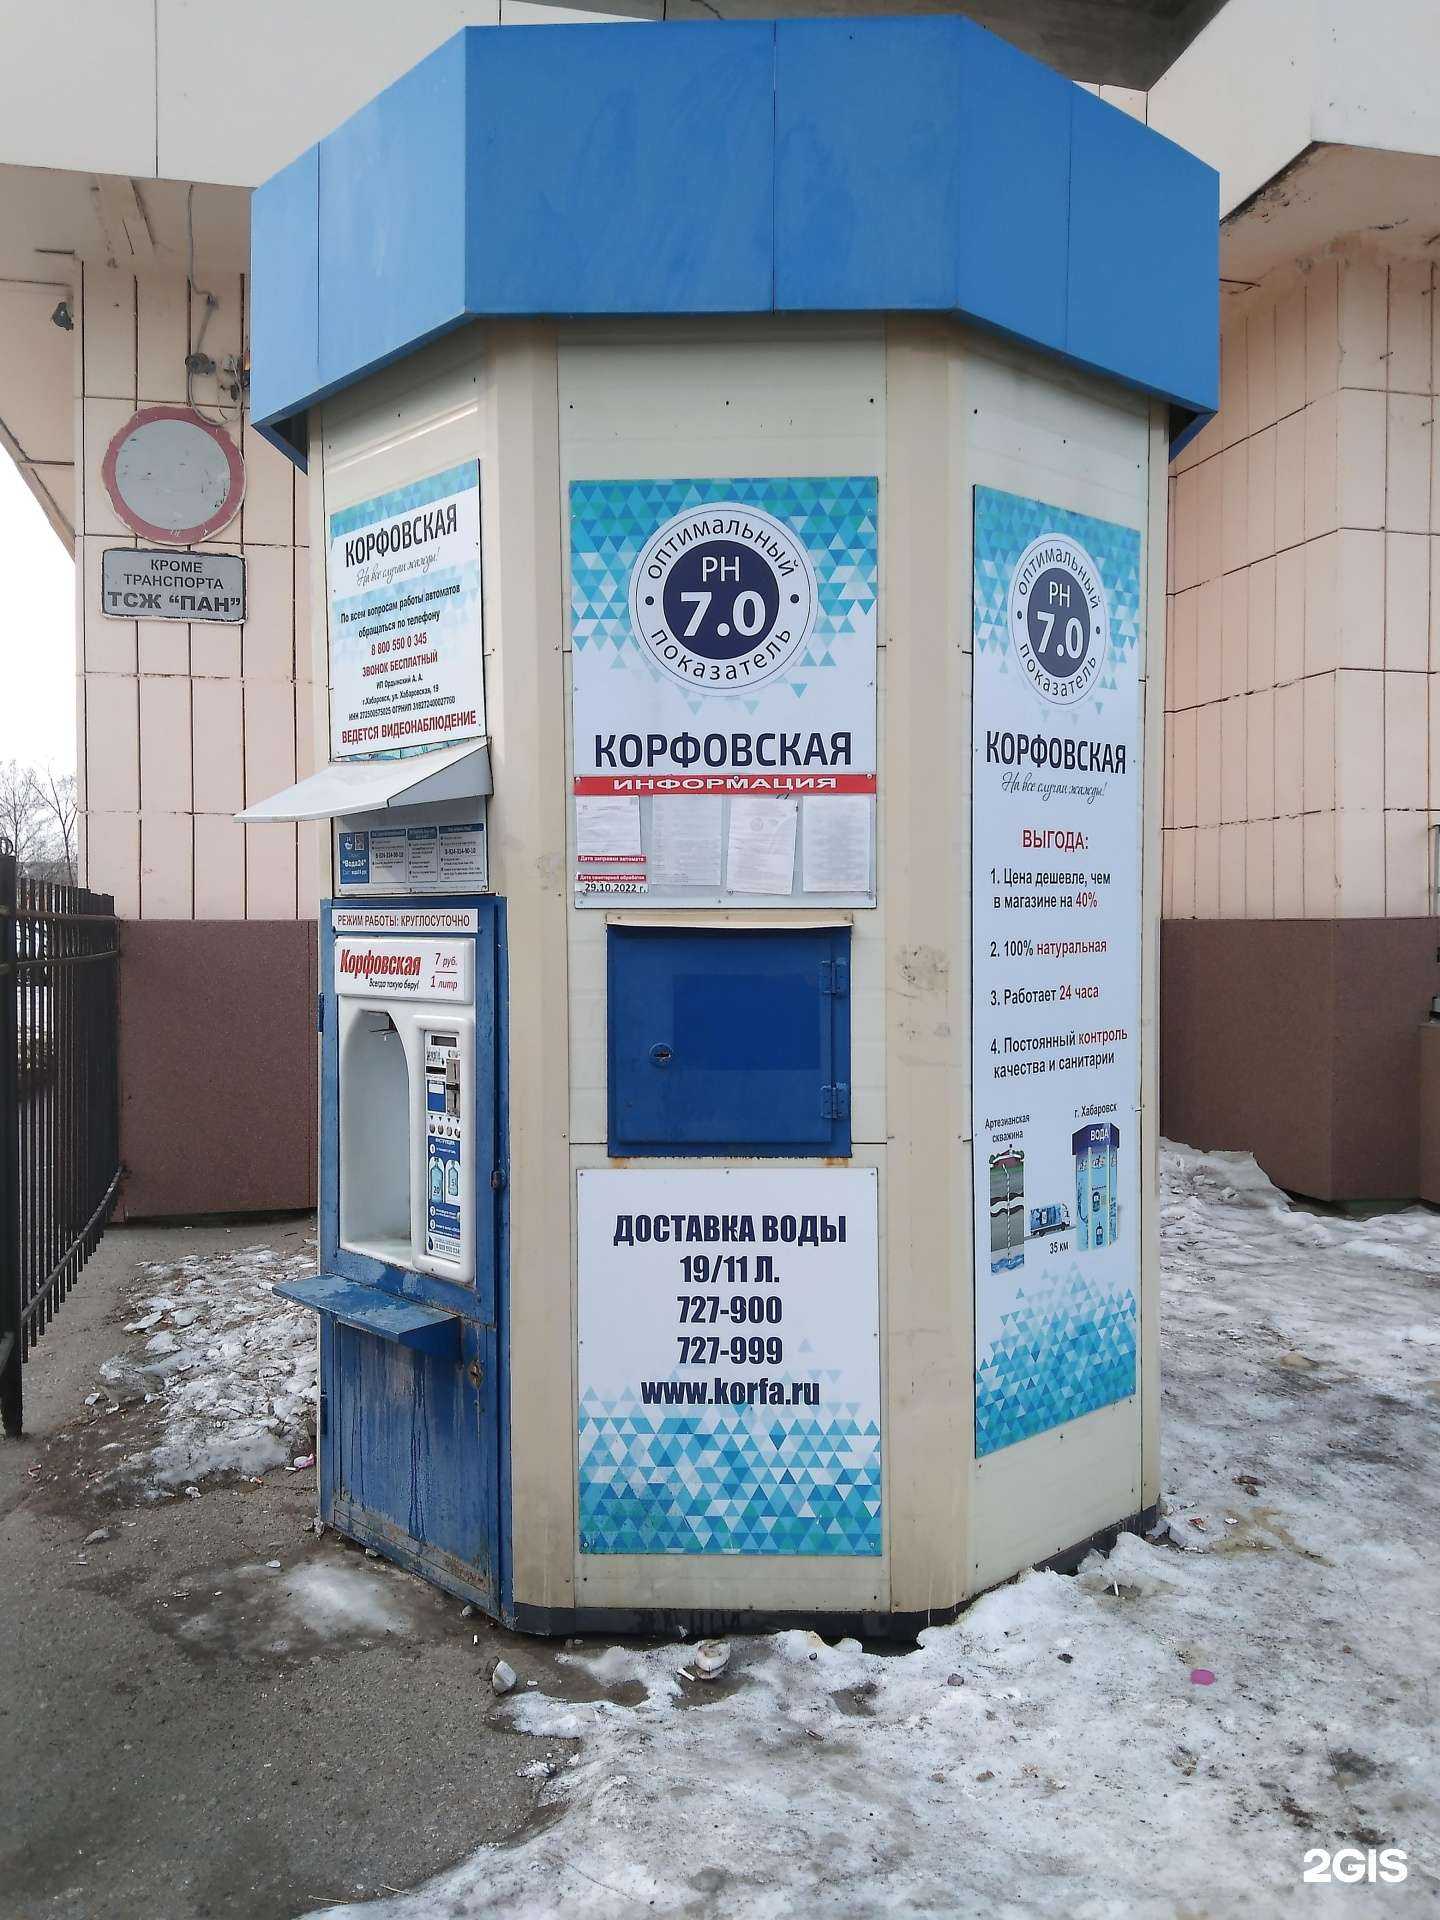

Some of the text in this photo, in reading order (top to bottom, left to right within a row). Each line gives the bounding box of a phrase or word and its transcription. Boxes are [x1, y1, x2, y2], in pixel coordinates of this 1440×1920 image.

[345, 504, 457, 568] КОРФОВСКАЯ
[647, 518, 795, 580] оптимальный
[151, 559, 203, 574] КРОМЕ
[124, 573, 224, 590] ТРАНСПОРТА
[108, 592, 161, 609] ТСЖ
[340, 584, 460, 624] По всем вопросам работы автоматов
[358, 610, 440, 639] обращаться по телефону
[681, 590, 766, 637] 7.0
[371, 632, 427, 656] 8 800 550 0 345
[1037, 611, 1083, 659] 7.0
[362, 649, 438, 677] ЗВОНОК БЕСПЛАТНЫЙ
[651, 629, 791, 680] показатель
[342, 710, 476, 745] ВЕДЕТСЯ ВИДЕОНАБЛЮДЕНИЕ
[595, 732, 852, 768] КОРФОВСКАЯ
[986, 731, 1126, 774] КОРФОВСКАЯ
[613, 777, 836, 790] ИНФОРМАЦИЯ
[1002, 772, 1108, 804] На все случаи жажды!
[1023, 830, 1088, 852] ВЫГОДА:
[585, 883, 636, 892] 29.10.2022
[991, 868, 1111, 887] 1. Цена дешевле, чем
[994, 892, 1098, 908] в магазине на 40%
[338, 915, 470, 927] РЕЖИМ РАБОТЫ: КРУГЛОСУТОЧНО
[435, 953, 458, 967] 7 руб.
[990, 940, 1107, 958] 2. 100% натуральная
[340, 949, 421, 979] Корфовская
[369, 978, 419, 991] Всегда такую беру!
[431, 976, 457, 991] 1 литр
[991, 985, 1099, 1006] 3. Работает 24 часа
[991, 1029, 1128, 1054] 4. Постоянный контроль
[994, 1052, 1115, 1078] качества и санитарии
[985, 1113, 1030, 1131] Артезианская
[1074, 1103, 1118, 1118] г. Хабаровск
[992, 1130, 1024, 1143] скважина
[1090, 1128, 1109, 1141] ВОДА
[613, 1215, 847, 1246] ДОСТАВКА ВОДЫ
[1050, 1241, 1069, 1254] 35 км
[680, 1255, 780, 1283] 19/11 Л.
[677, 1296, 782, 1323] 727-900
[677, 1337, 783, 1364] 727-999
[641, 1378, 820, 1405] www.korfa.ru
